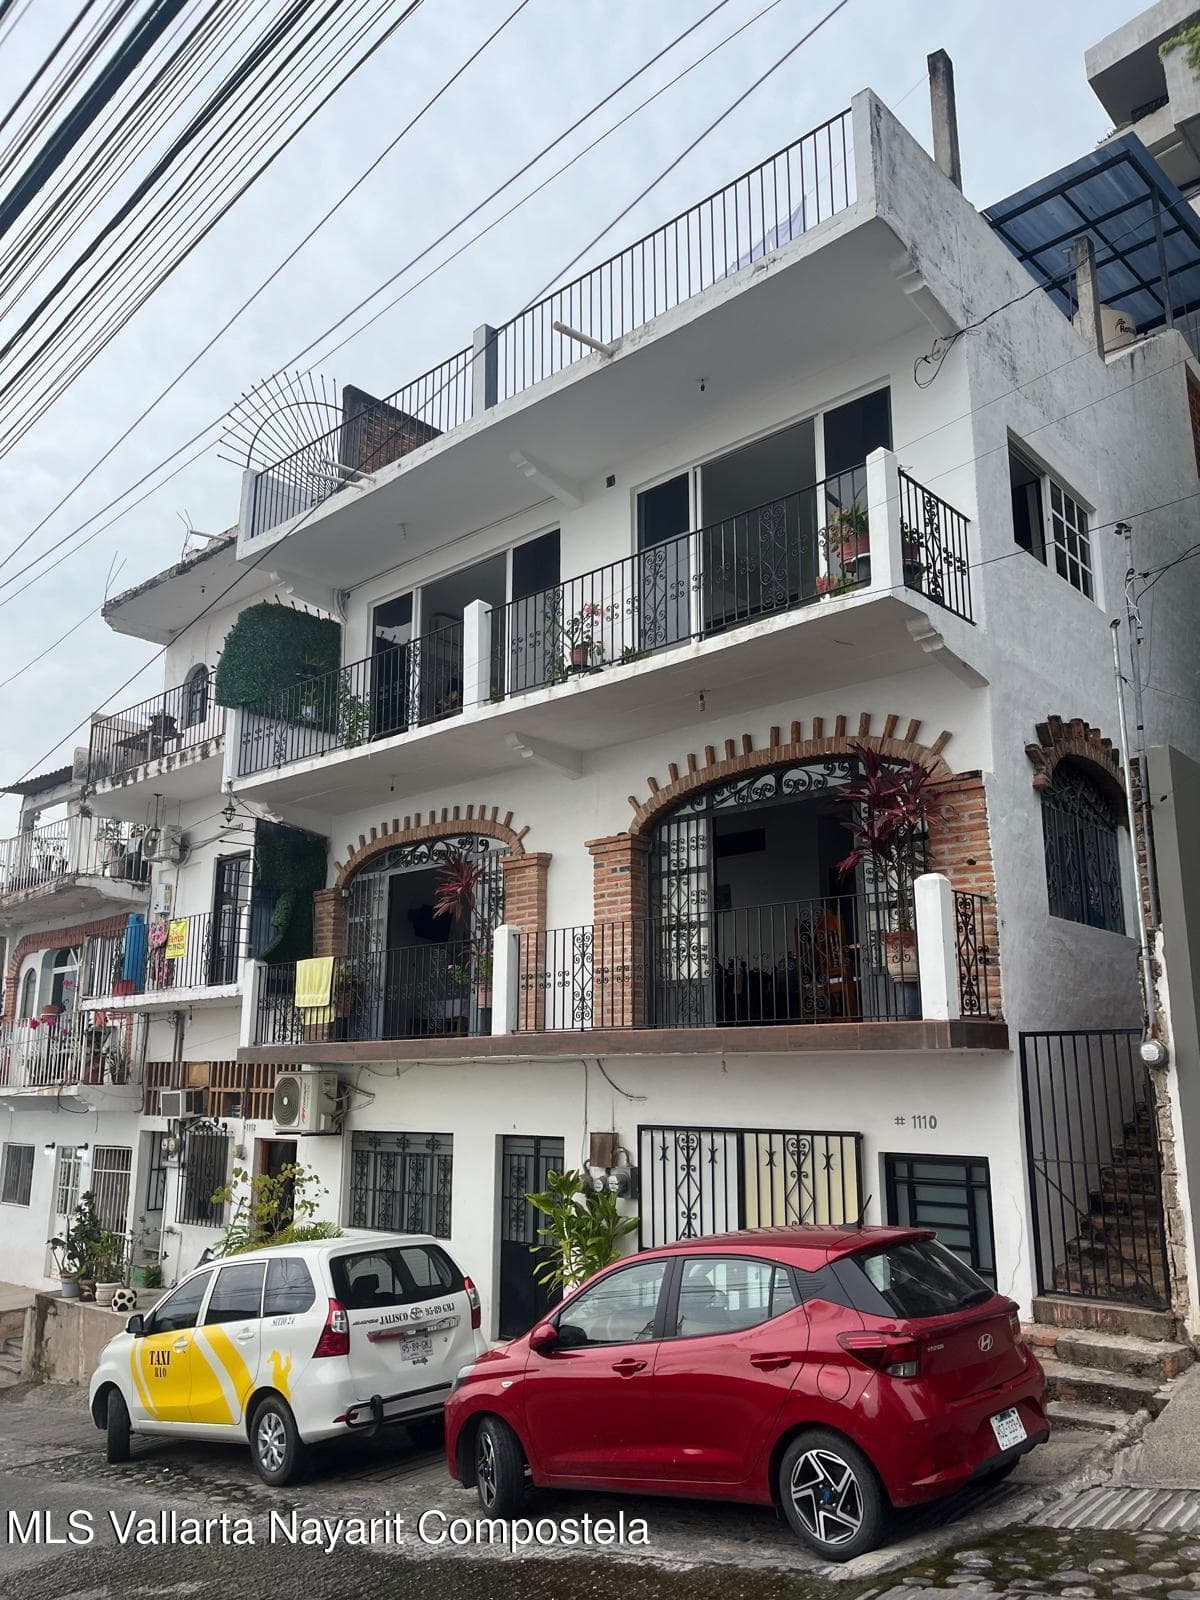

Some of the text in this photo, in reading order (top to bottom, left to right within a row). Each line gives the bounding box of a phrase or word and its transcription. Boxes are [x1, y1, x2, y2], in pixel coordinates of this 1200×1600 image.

[911, 1115, 938, 1129] 1110
[380, 1312, 409, 1325] JALISCO
[149, 1350, 170, 1365] TAXI
[155, 1367, 167, 1377] 810
